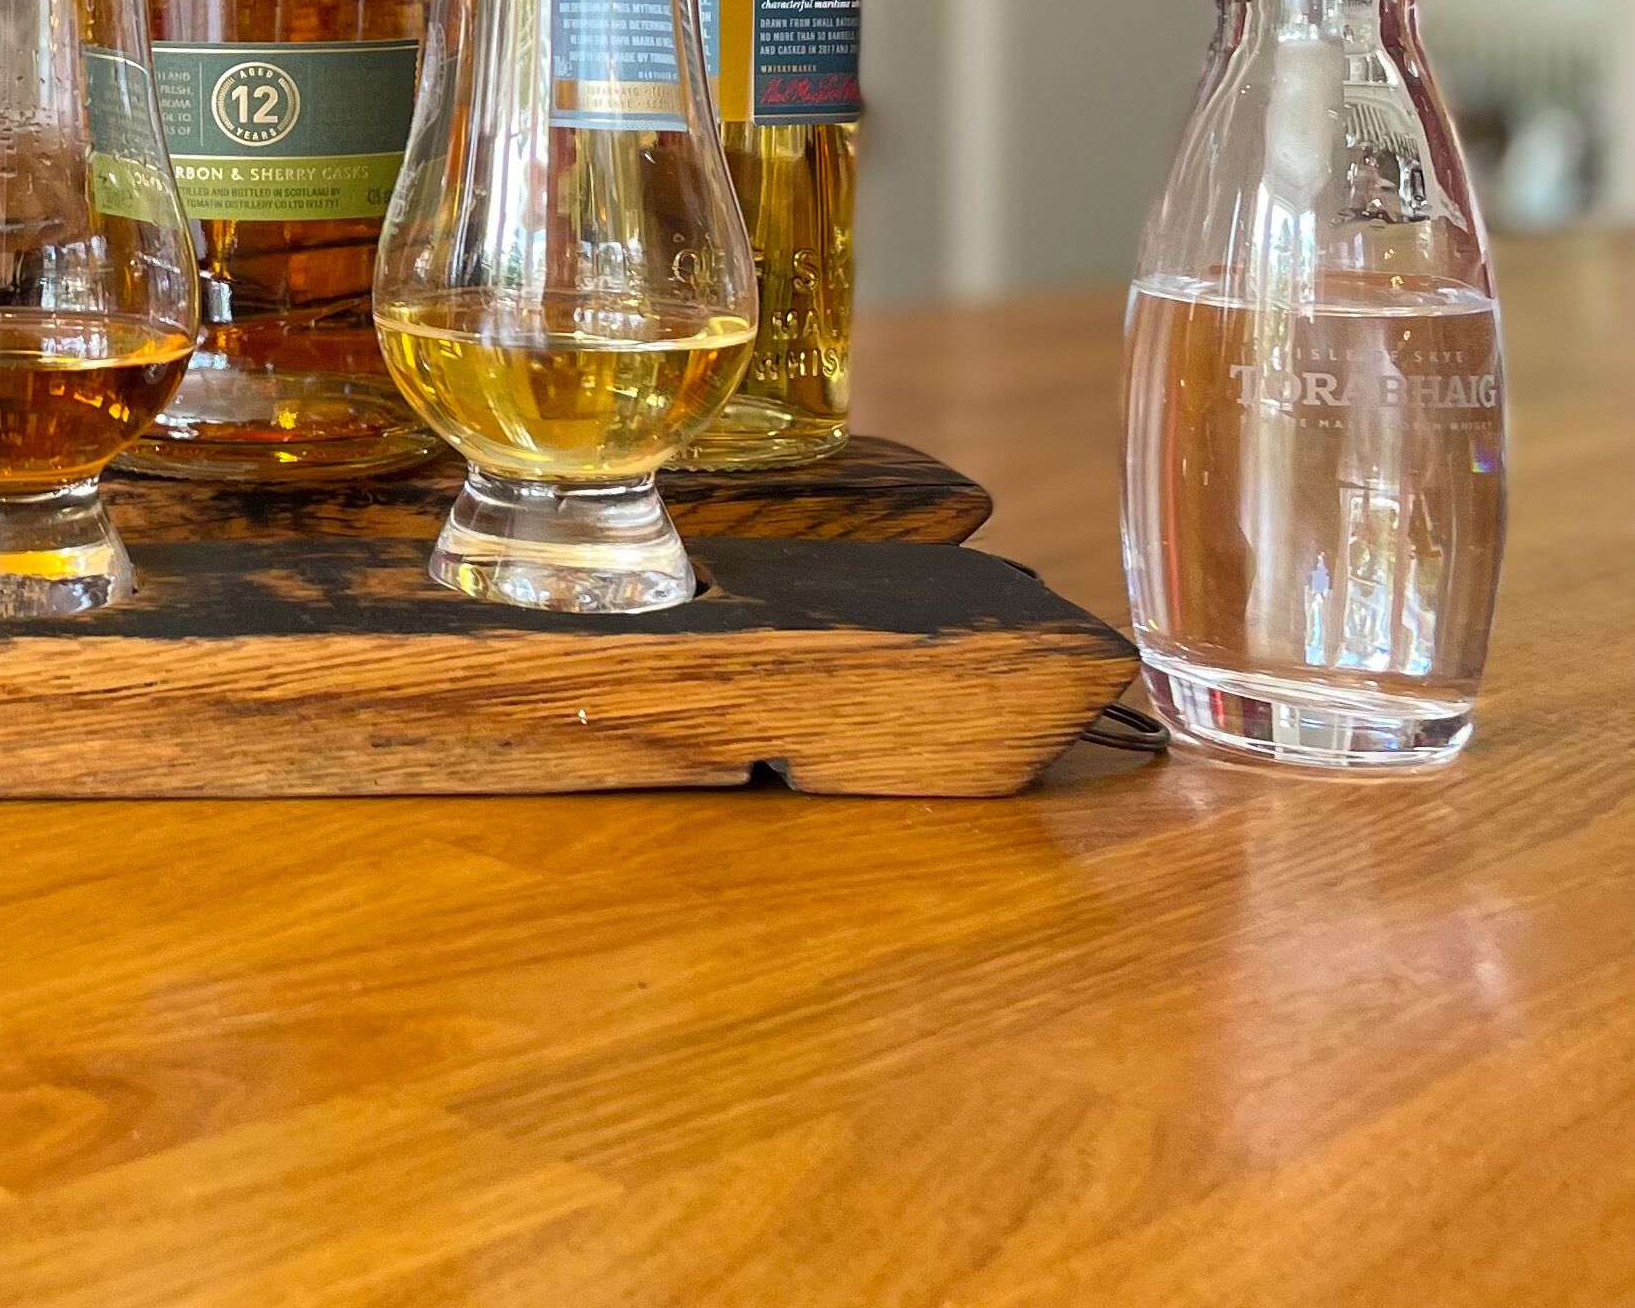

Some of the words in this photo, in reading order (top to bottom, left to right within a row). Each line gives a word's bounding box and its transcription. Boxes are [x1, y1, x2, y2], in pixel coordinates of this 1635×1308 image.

[760, 19, 787, 28] DRAWN
[789, 18, 811, 28] FROM
[812, 18, 834, 28] SMALL
[760, 32, 771, 42] NO
[773, 32, 794, 42] MORE
[796, 31, 815, 41] THAN
[760, 46, 775, 55] AND
[777, 45, 805, 55] CASKED
[808, 45, 817, 54] IN
[167, 72, 191, 81] AND
[239, 67, 273, 79] AGED
[161, 99, 192, 109] ROMA
[231, 85, 279, 123] 12
[236, 127, 277, 141] YEARS
[174, 166, 223, 181] RBON
[231, 167, 245, 181] &
[250, 167, 316, 181] SHERRY
[322, 165, 369, 180] CASKS
[187, 198, 223, 208] TOMATIN
[225, 199, 272, 209] DISTILLERY
[1413, 350, 1465, 364] SKYE
